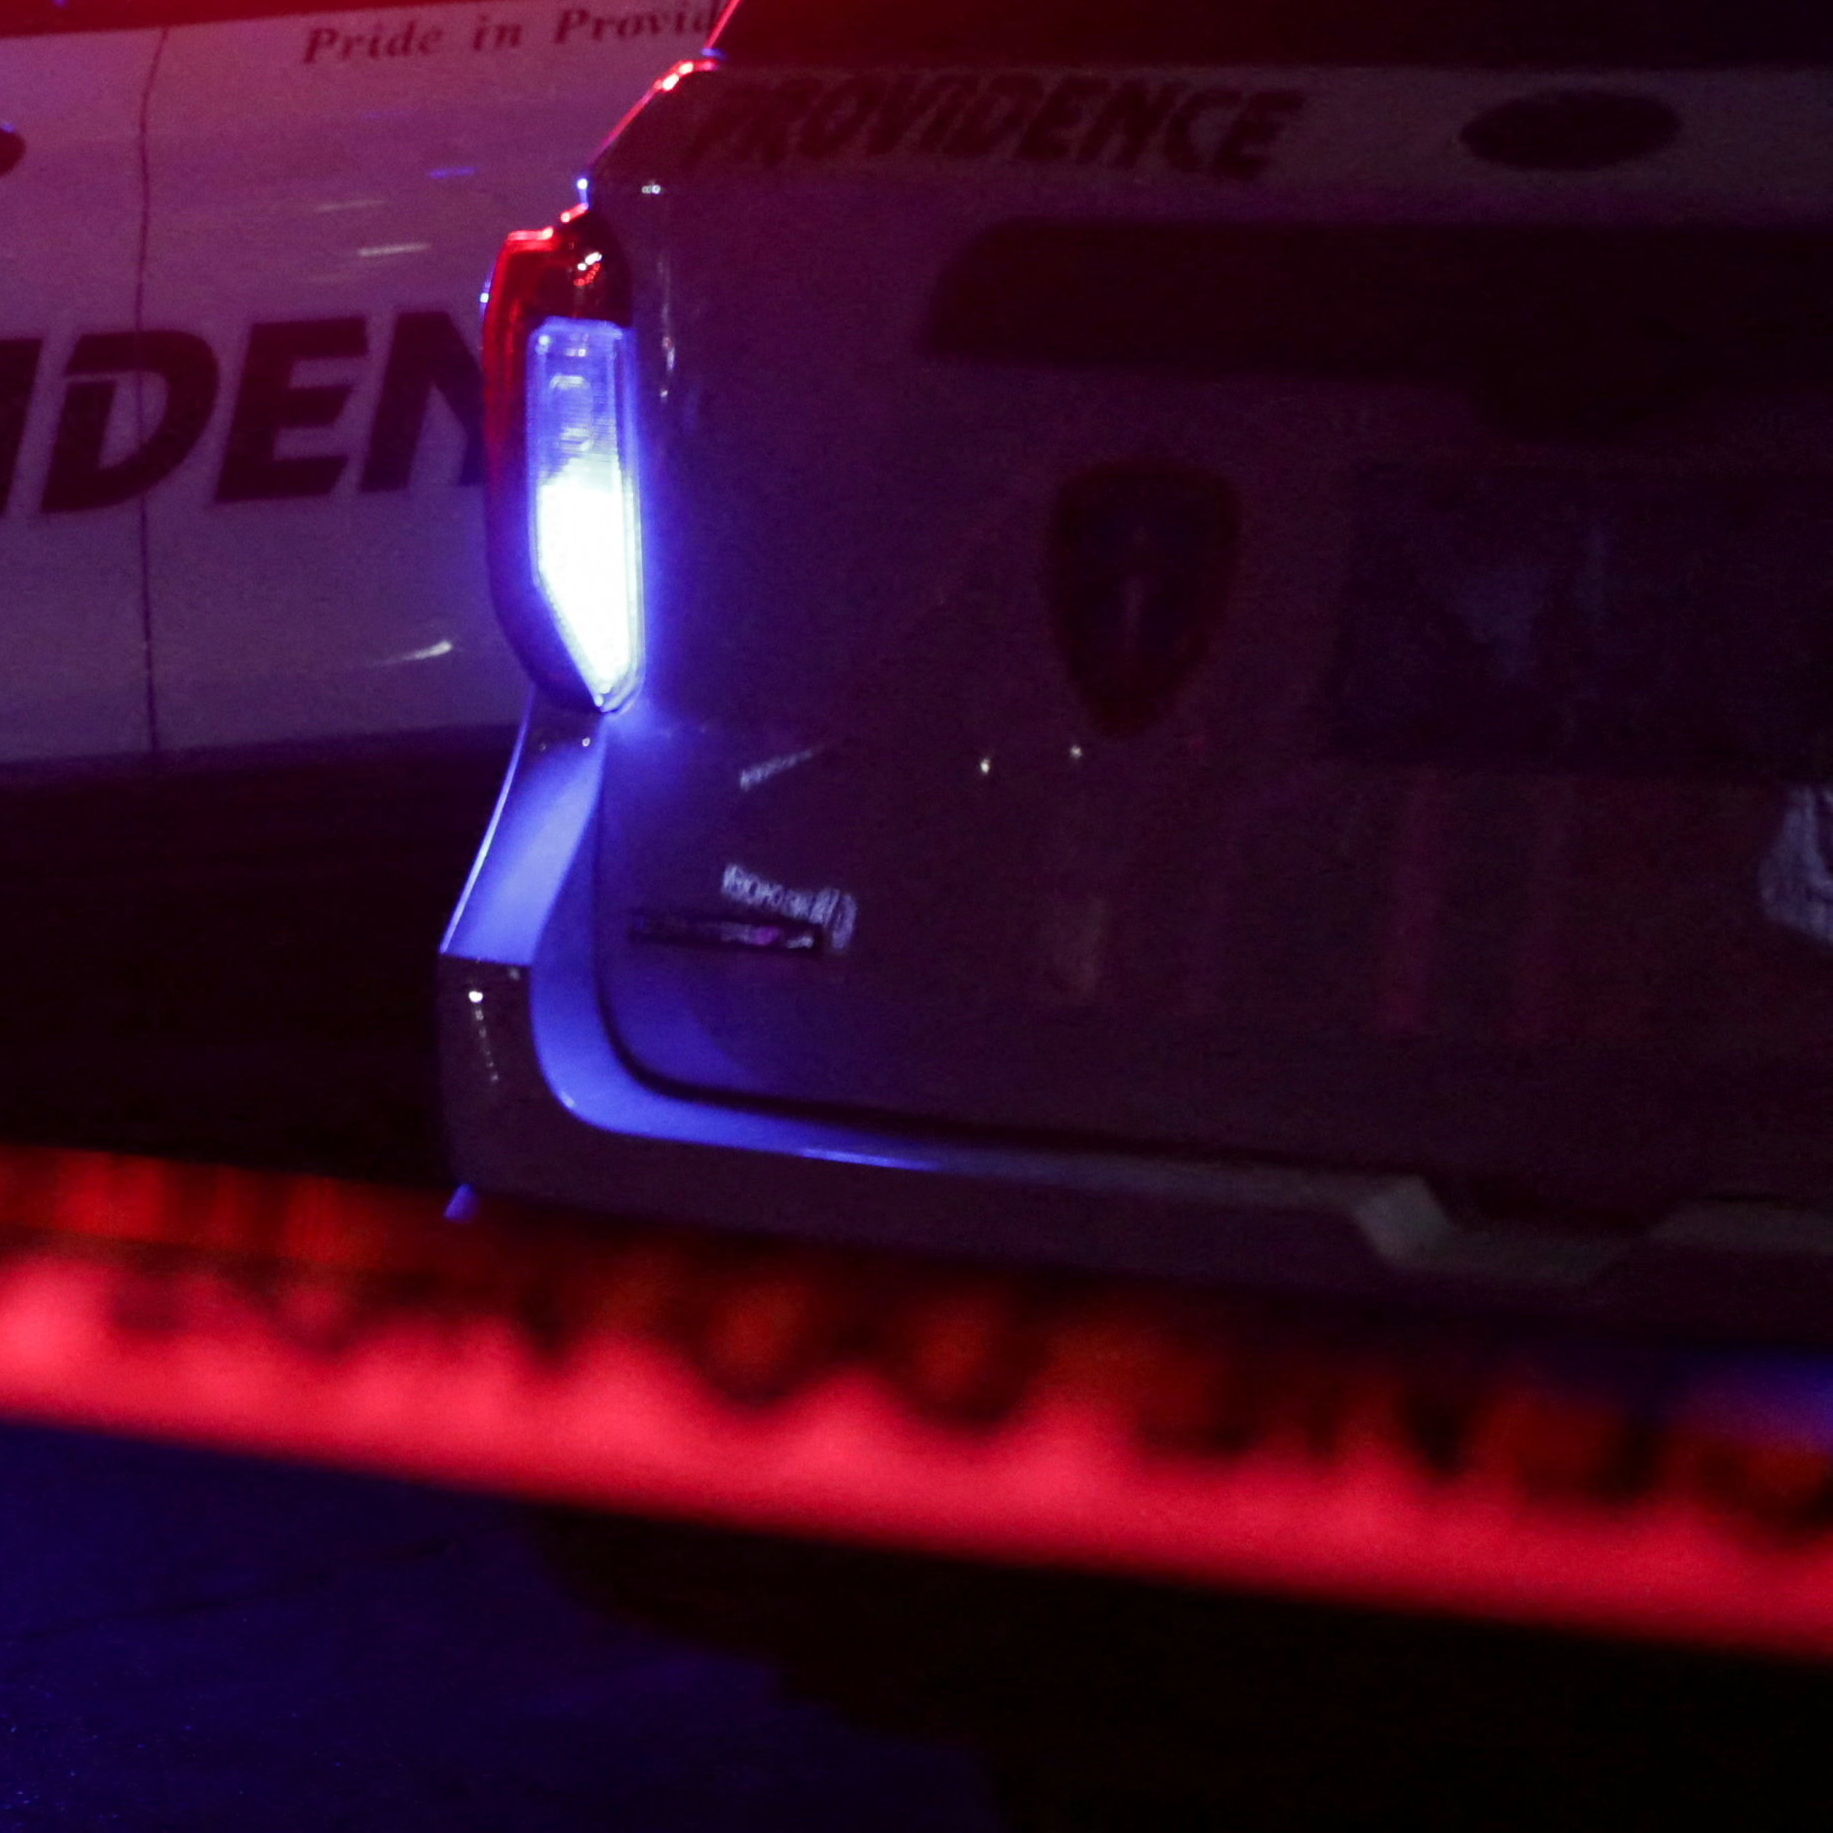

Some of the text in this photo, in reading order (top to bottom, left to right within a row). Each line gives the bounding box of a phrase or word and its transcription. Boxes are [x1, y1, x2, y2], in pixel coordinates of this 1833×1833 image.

[303, 20, 444, 63] Pride
[472, 14, 523, 51] in
[679, 72, 1303, 180] PROVIDENCE
